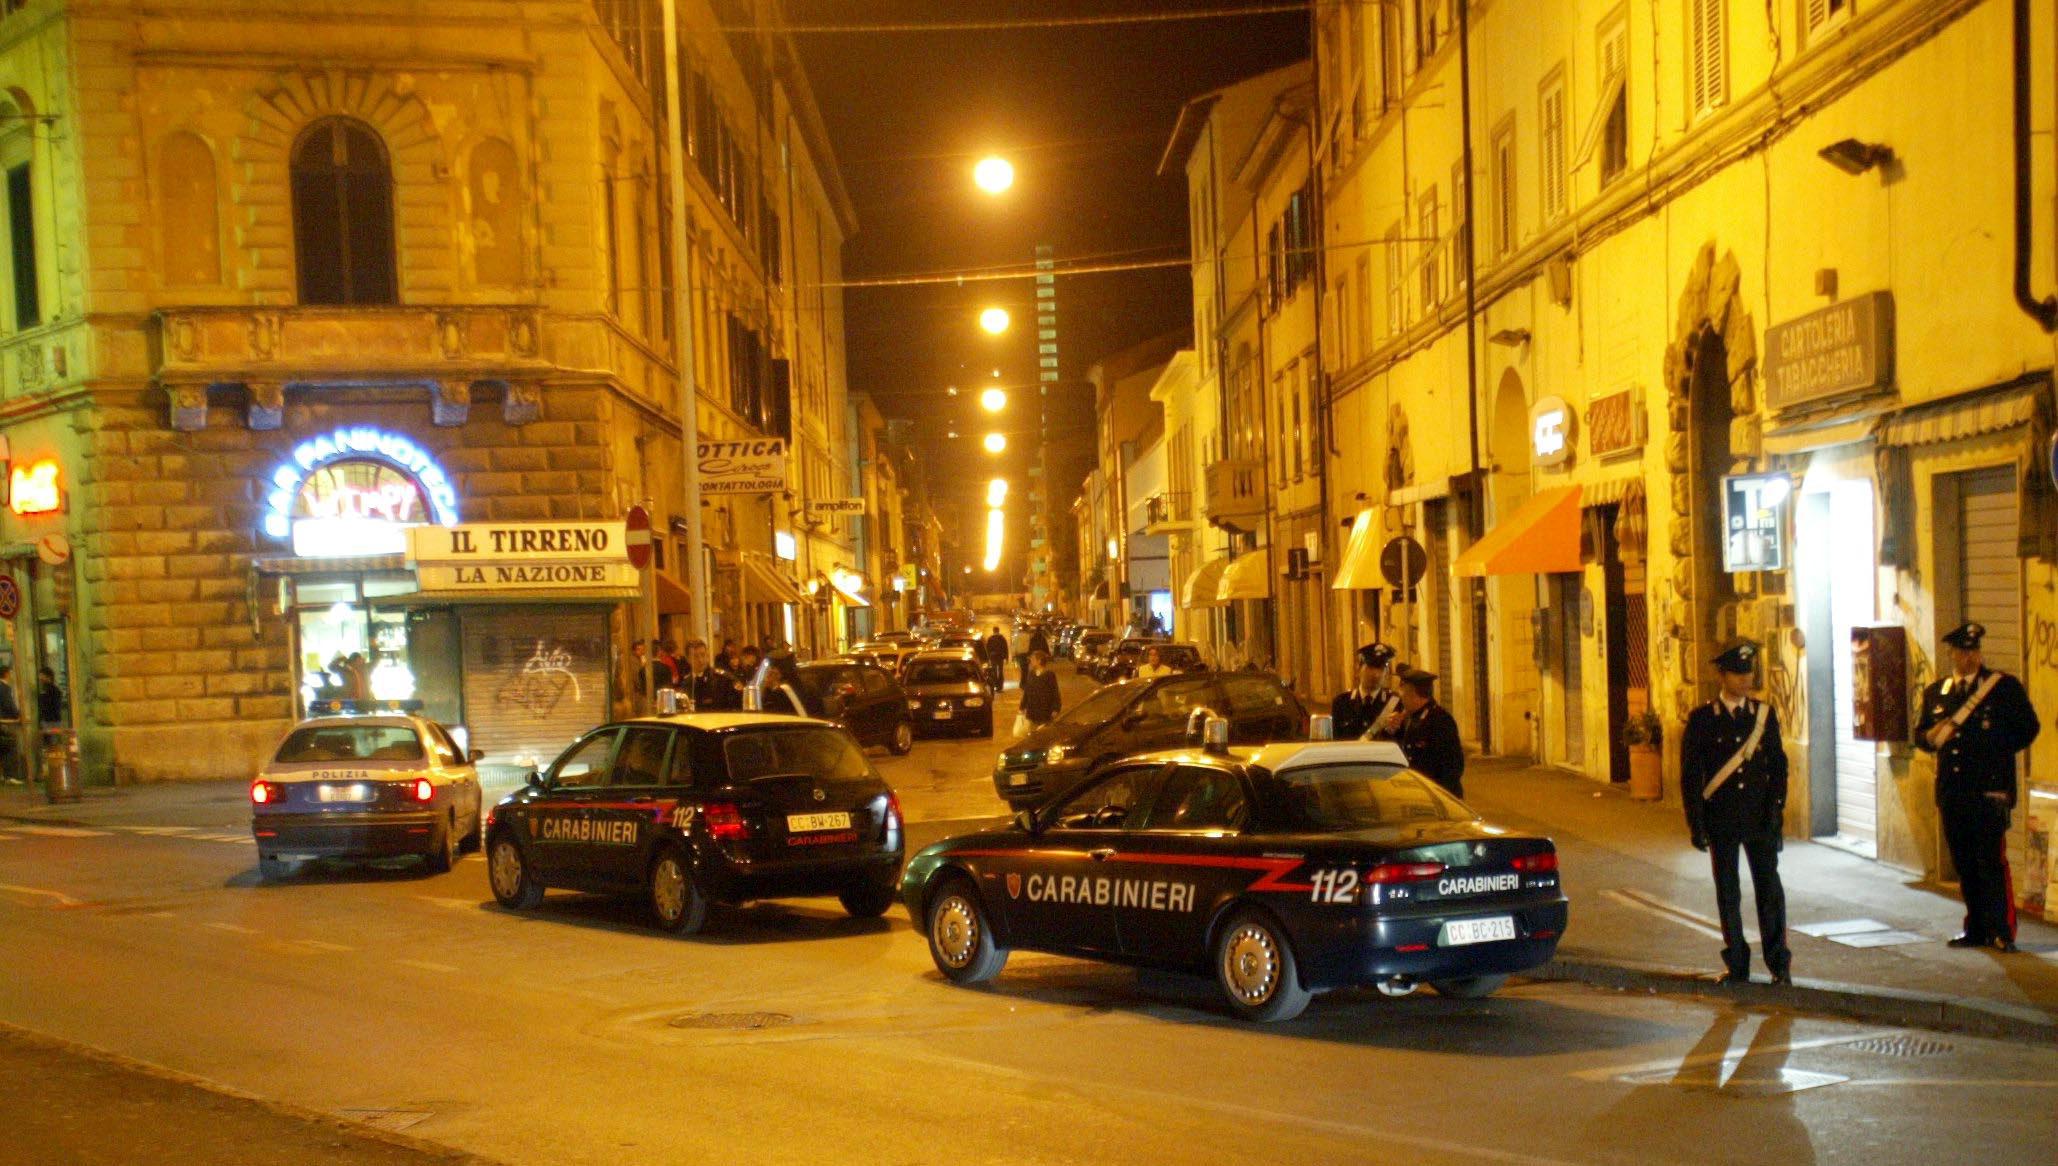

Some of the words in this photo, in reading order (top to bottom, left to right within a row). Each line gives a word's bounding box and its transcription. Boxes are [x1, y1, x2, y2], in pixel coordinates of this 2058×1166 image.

[1781, 307, 1854, 358] CARTOLERIA
[1777, 345, 1863, 401] TABACCHERIA
[697, 440, 782, 458] OTTICA
[699, 480, 783, 491] ONTATTOLOGIA
[815, 500, 863, 511] amplifon
[450, 530, 477, 553] IL
[490, 529, 608, 552] TIRRENO
[455, 567, 485, 583] LA
[496, 565, 605, 583] NAZIONE
[312, 770, 369, 779] POLIZIA
[672, 806, 694, 829] 112
[543, 816, 638, 843] CARABINIERI
[1027, 873, 1196, 912] CARABINIERI
[1310, 869, 1358, 903] 112
[1438, 874, 1519, 895] CARABINIERI
